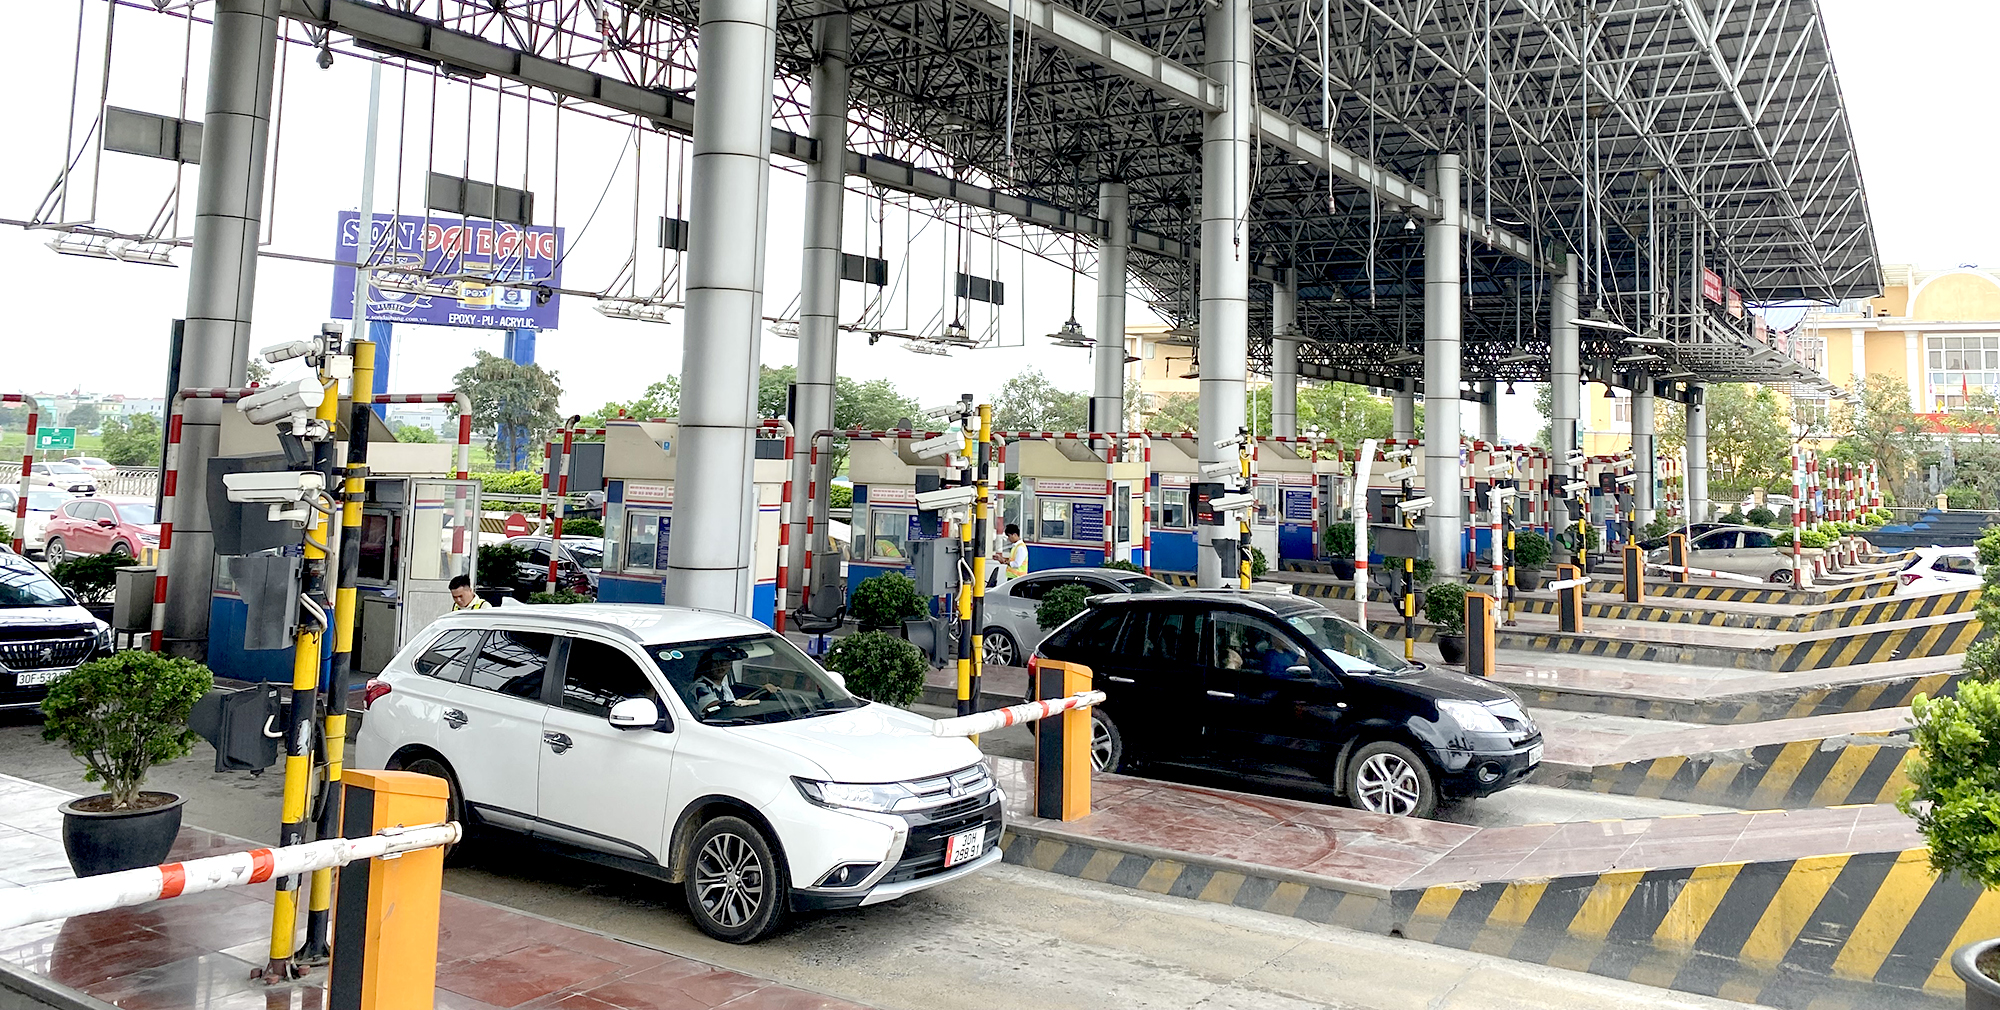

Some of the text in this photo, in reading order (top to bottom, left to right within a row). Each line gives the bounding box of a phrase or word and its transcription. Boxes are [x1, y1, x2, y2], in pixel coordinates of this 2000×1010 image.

[417, 223, 472, 260] ĐẠI
[476, 222, 558, 260] BÀNG
[448, 313, 476, 325] EPOXY
[481, 315, 494, 326] PU
[962, 832, 978, 847] 30H
